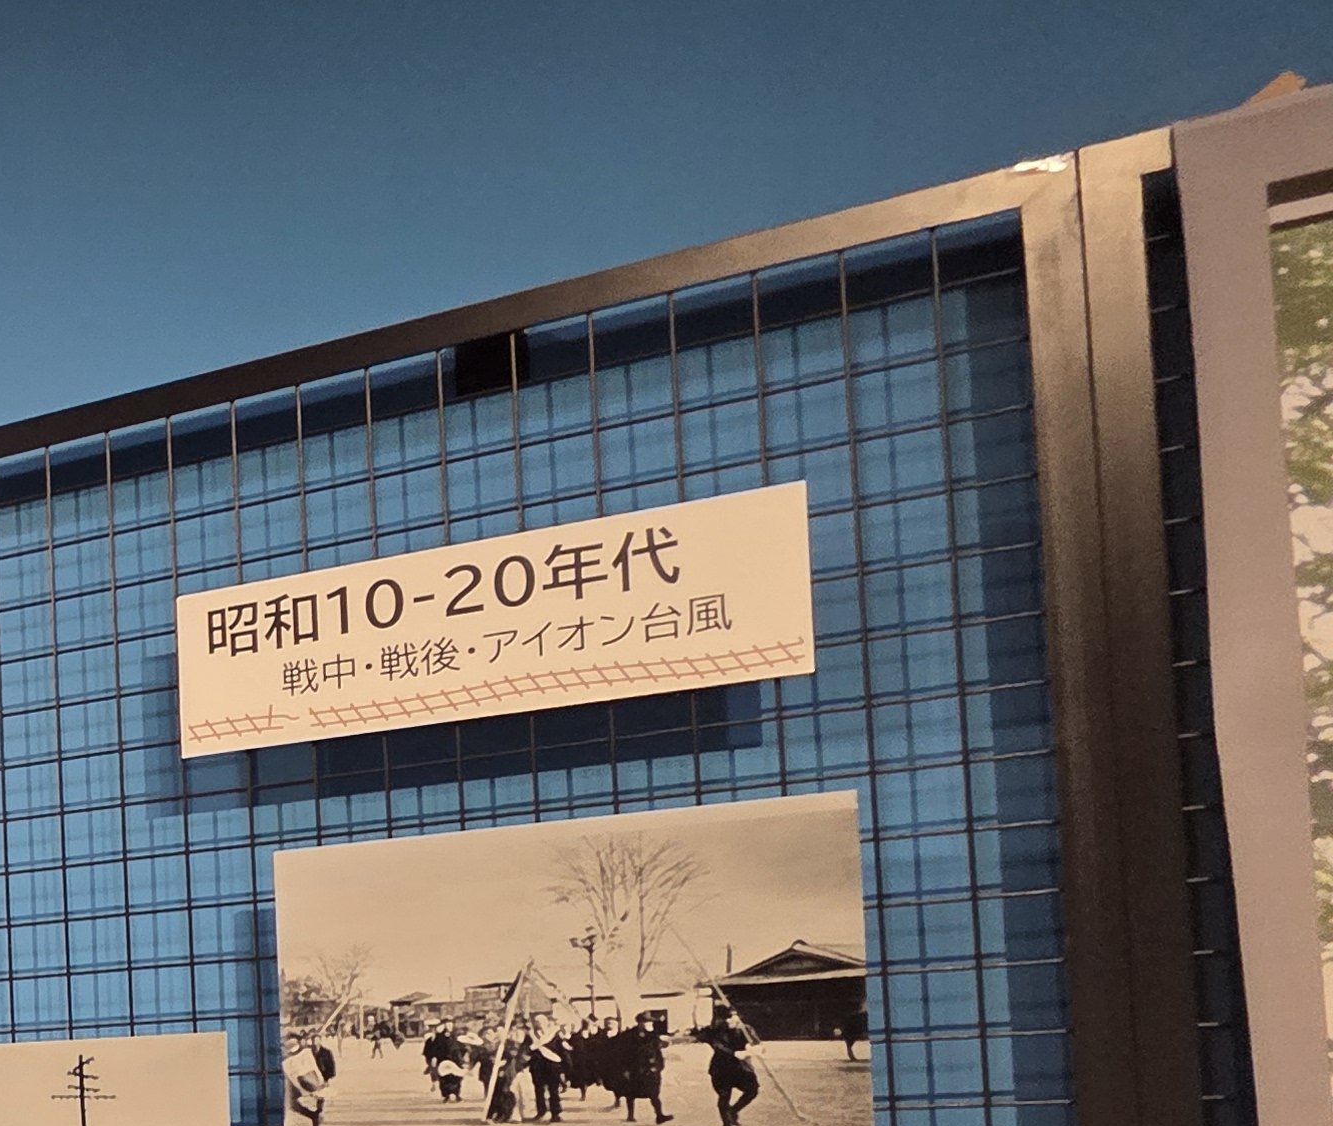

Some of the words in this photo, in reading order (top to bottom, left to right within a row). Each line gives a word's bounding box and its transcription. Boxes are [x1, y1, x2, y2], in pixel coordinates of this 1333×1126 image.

[207, 526, 682, 656] 昭和10-20年代
[282, 592, 733, 695] 戦中・戦後・アイオン台風
